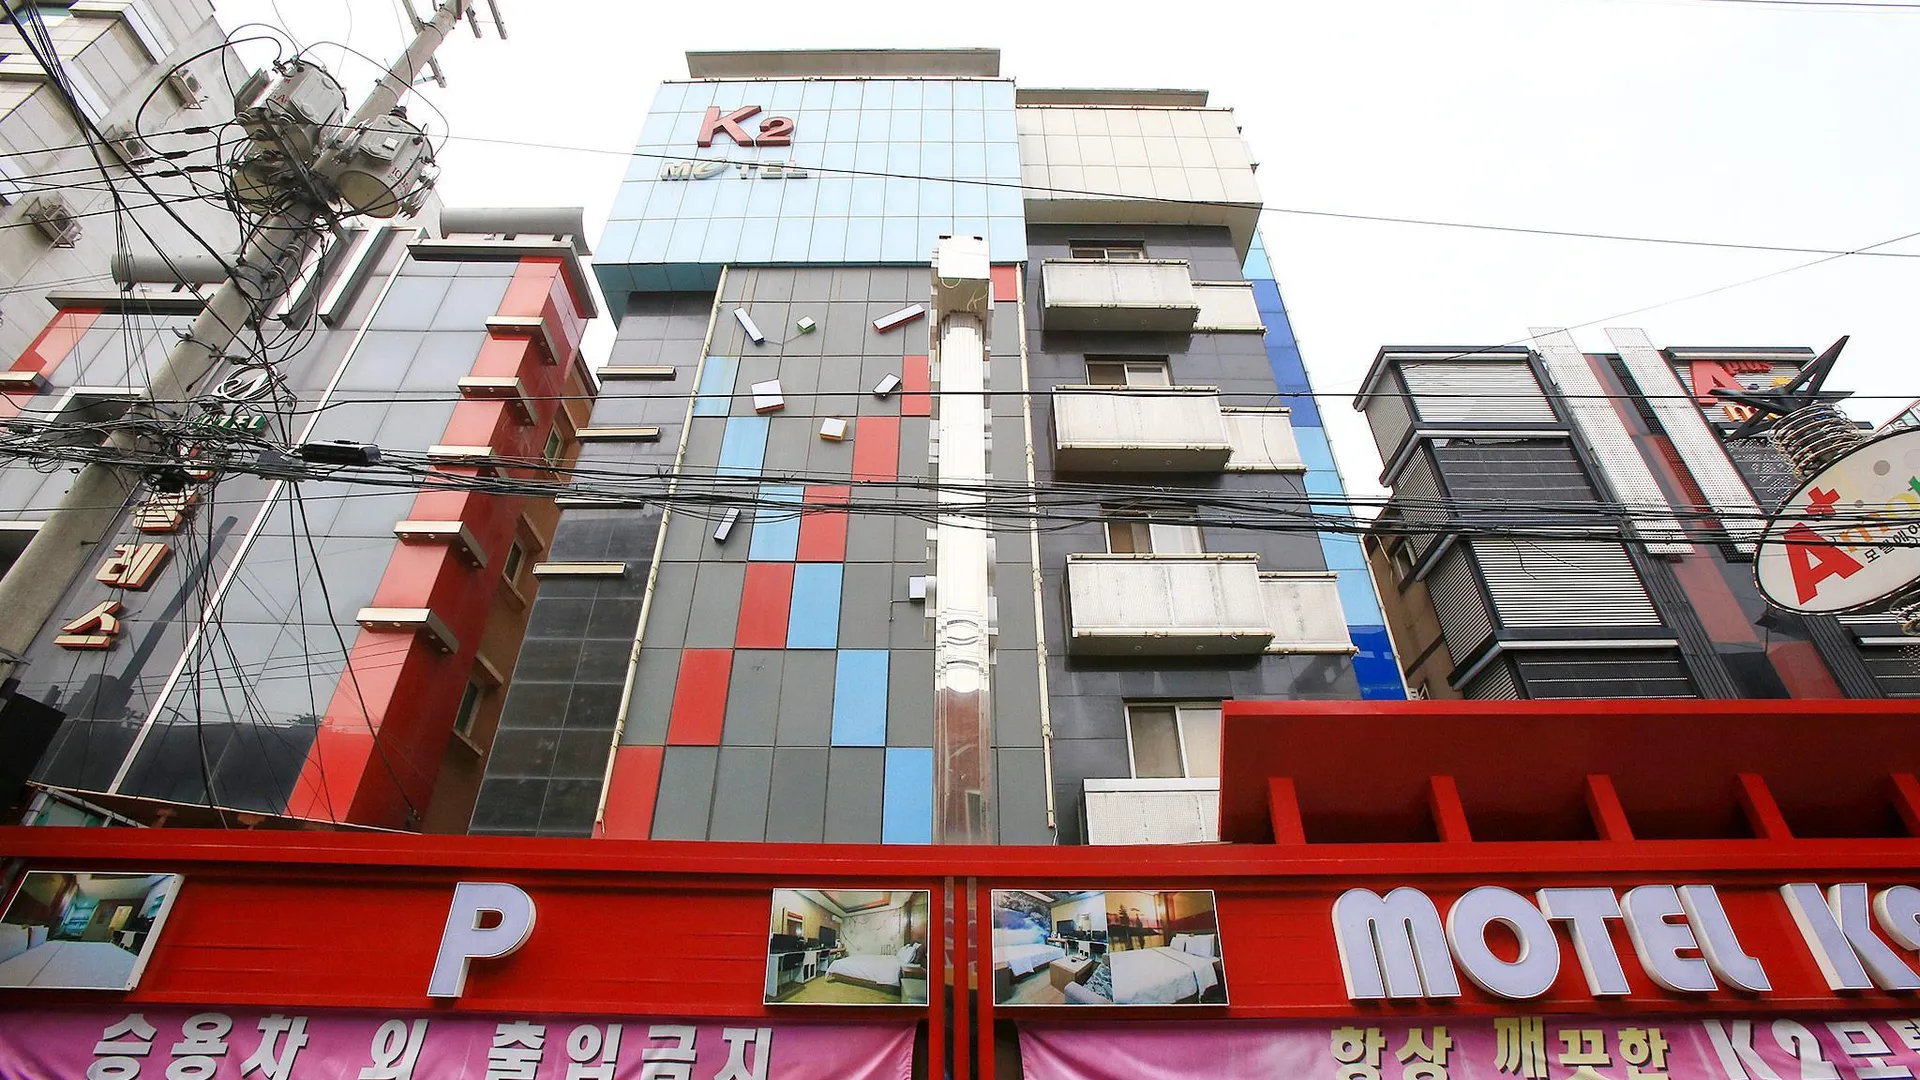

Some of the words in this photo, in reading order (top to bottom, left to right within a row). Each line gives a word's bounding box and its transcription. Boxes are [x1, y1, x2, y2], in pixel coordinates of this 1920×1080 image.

[697, 105, 794, 147] K2
[661, 157, 808, 181] MOTEL
[427, 881, 537, 998] P
[1331, 884, 1772, 999] MOTEL
[86, 1012, 310, 1080] 승용차
[357, 1018, 430, 1080] 외
[485, 1020, 773, 1080] 출입금지
[1330, 1026, 1453, 1080] 항상
[1493, 1017, 1670, 1080] 깨끗한
